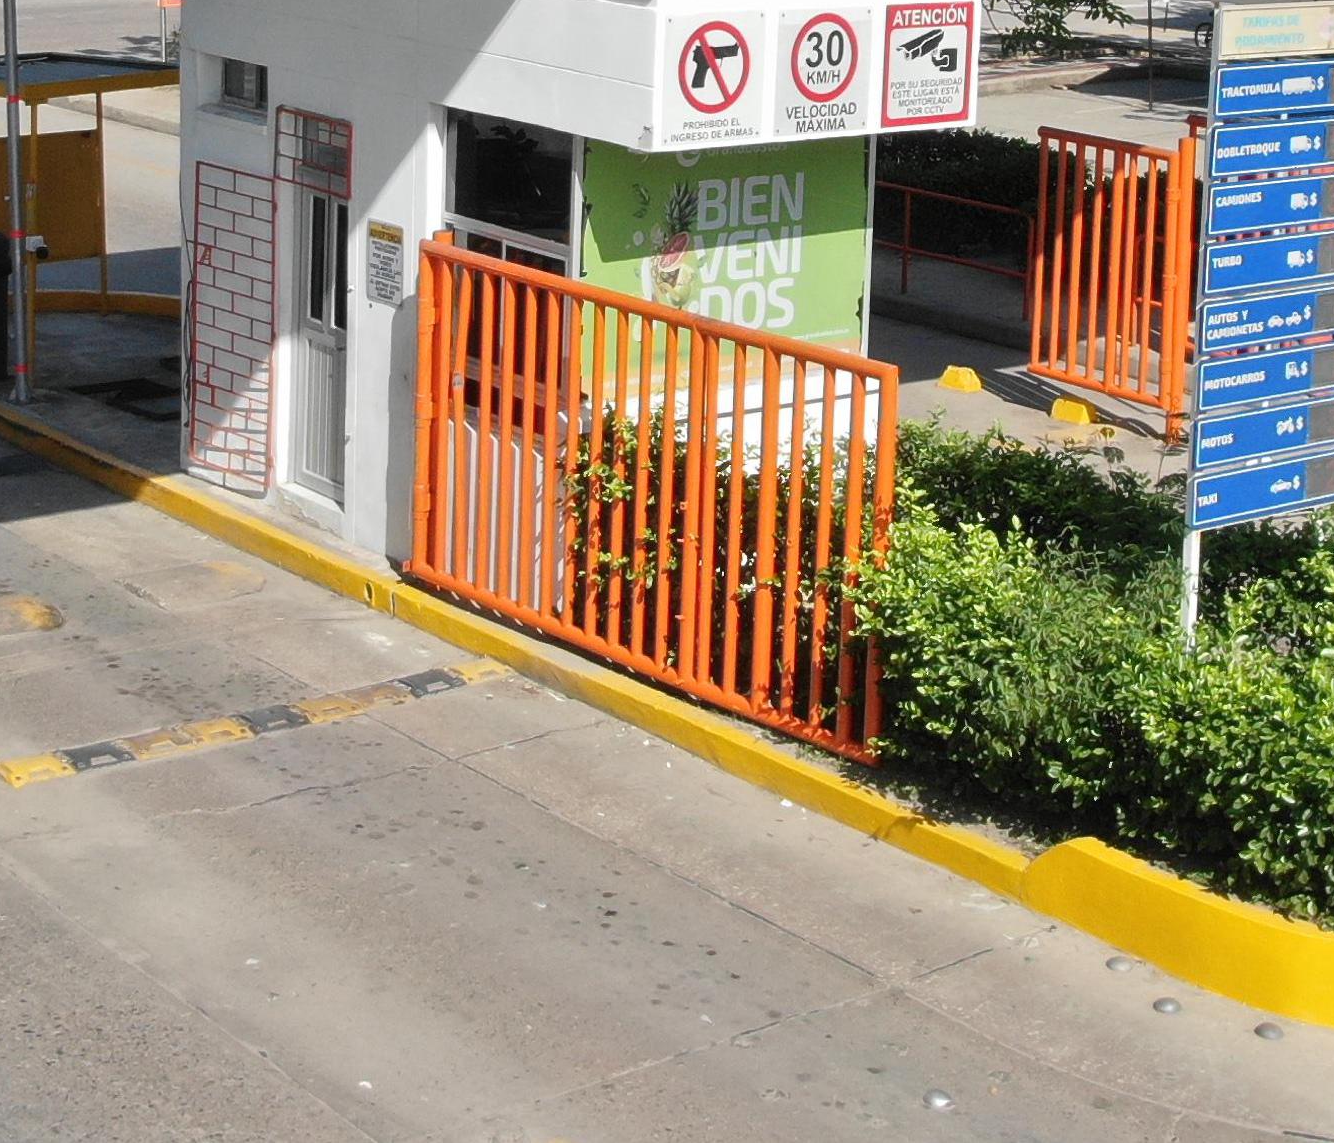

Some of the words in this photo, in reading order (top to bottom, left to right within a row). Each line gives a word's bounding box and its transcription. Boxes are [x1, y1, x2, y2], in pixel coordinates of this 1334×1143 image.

[892, 5, 967, 27] ATENCIÓN
[805, 29, 845, 68] 30
[806, 68, 842, 86] KM/H
[890, 81, 906, 90] POR
[908, 81, 919, 89] SU
[920, 76, 963, 88] SEGURIDAD
[892, 89, 912, 99] ESTE
[913, 88, 939, 97] LUGAR
[1221, 81, 1281, 99] TRACTOMULA
[898, 96, 954, 108] MONITOREADO
[906, 106, 923, 115] POR
[924, 104, 945, 115] CCTV
[785, 102, 857, 120] VELOCIDAD
[682, 119, 729, 130] PROHIBIDO
[732, 118, 741, 127] EL
[671, 131, 709, 143] INGRESO
[711, 130, 722, 139] DE
[724, 127, 754, 138] ARMAS
[1216, 141, 1281, 159] DOBLETROQUE
[696, 172, 804, 231] BIEN
[1215, 191, 1262, 208] CAMIONES
[694, 225, 802, 283] VENI
[1211, 254, 1243, 269] TURBO
[700, 278, 795, 329] DOS
[1207, 311, 1239, 326] AUTOS
[1242, 310, 1249, 321] Y
[1206, 322, 1265, 340] CAMIONETAS
[1204, 370, 1266, 391] MOTOCARROS
[1200, 433, 1234, 450] MOTOS
[1197, 492, 1218, 507] TAXI
